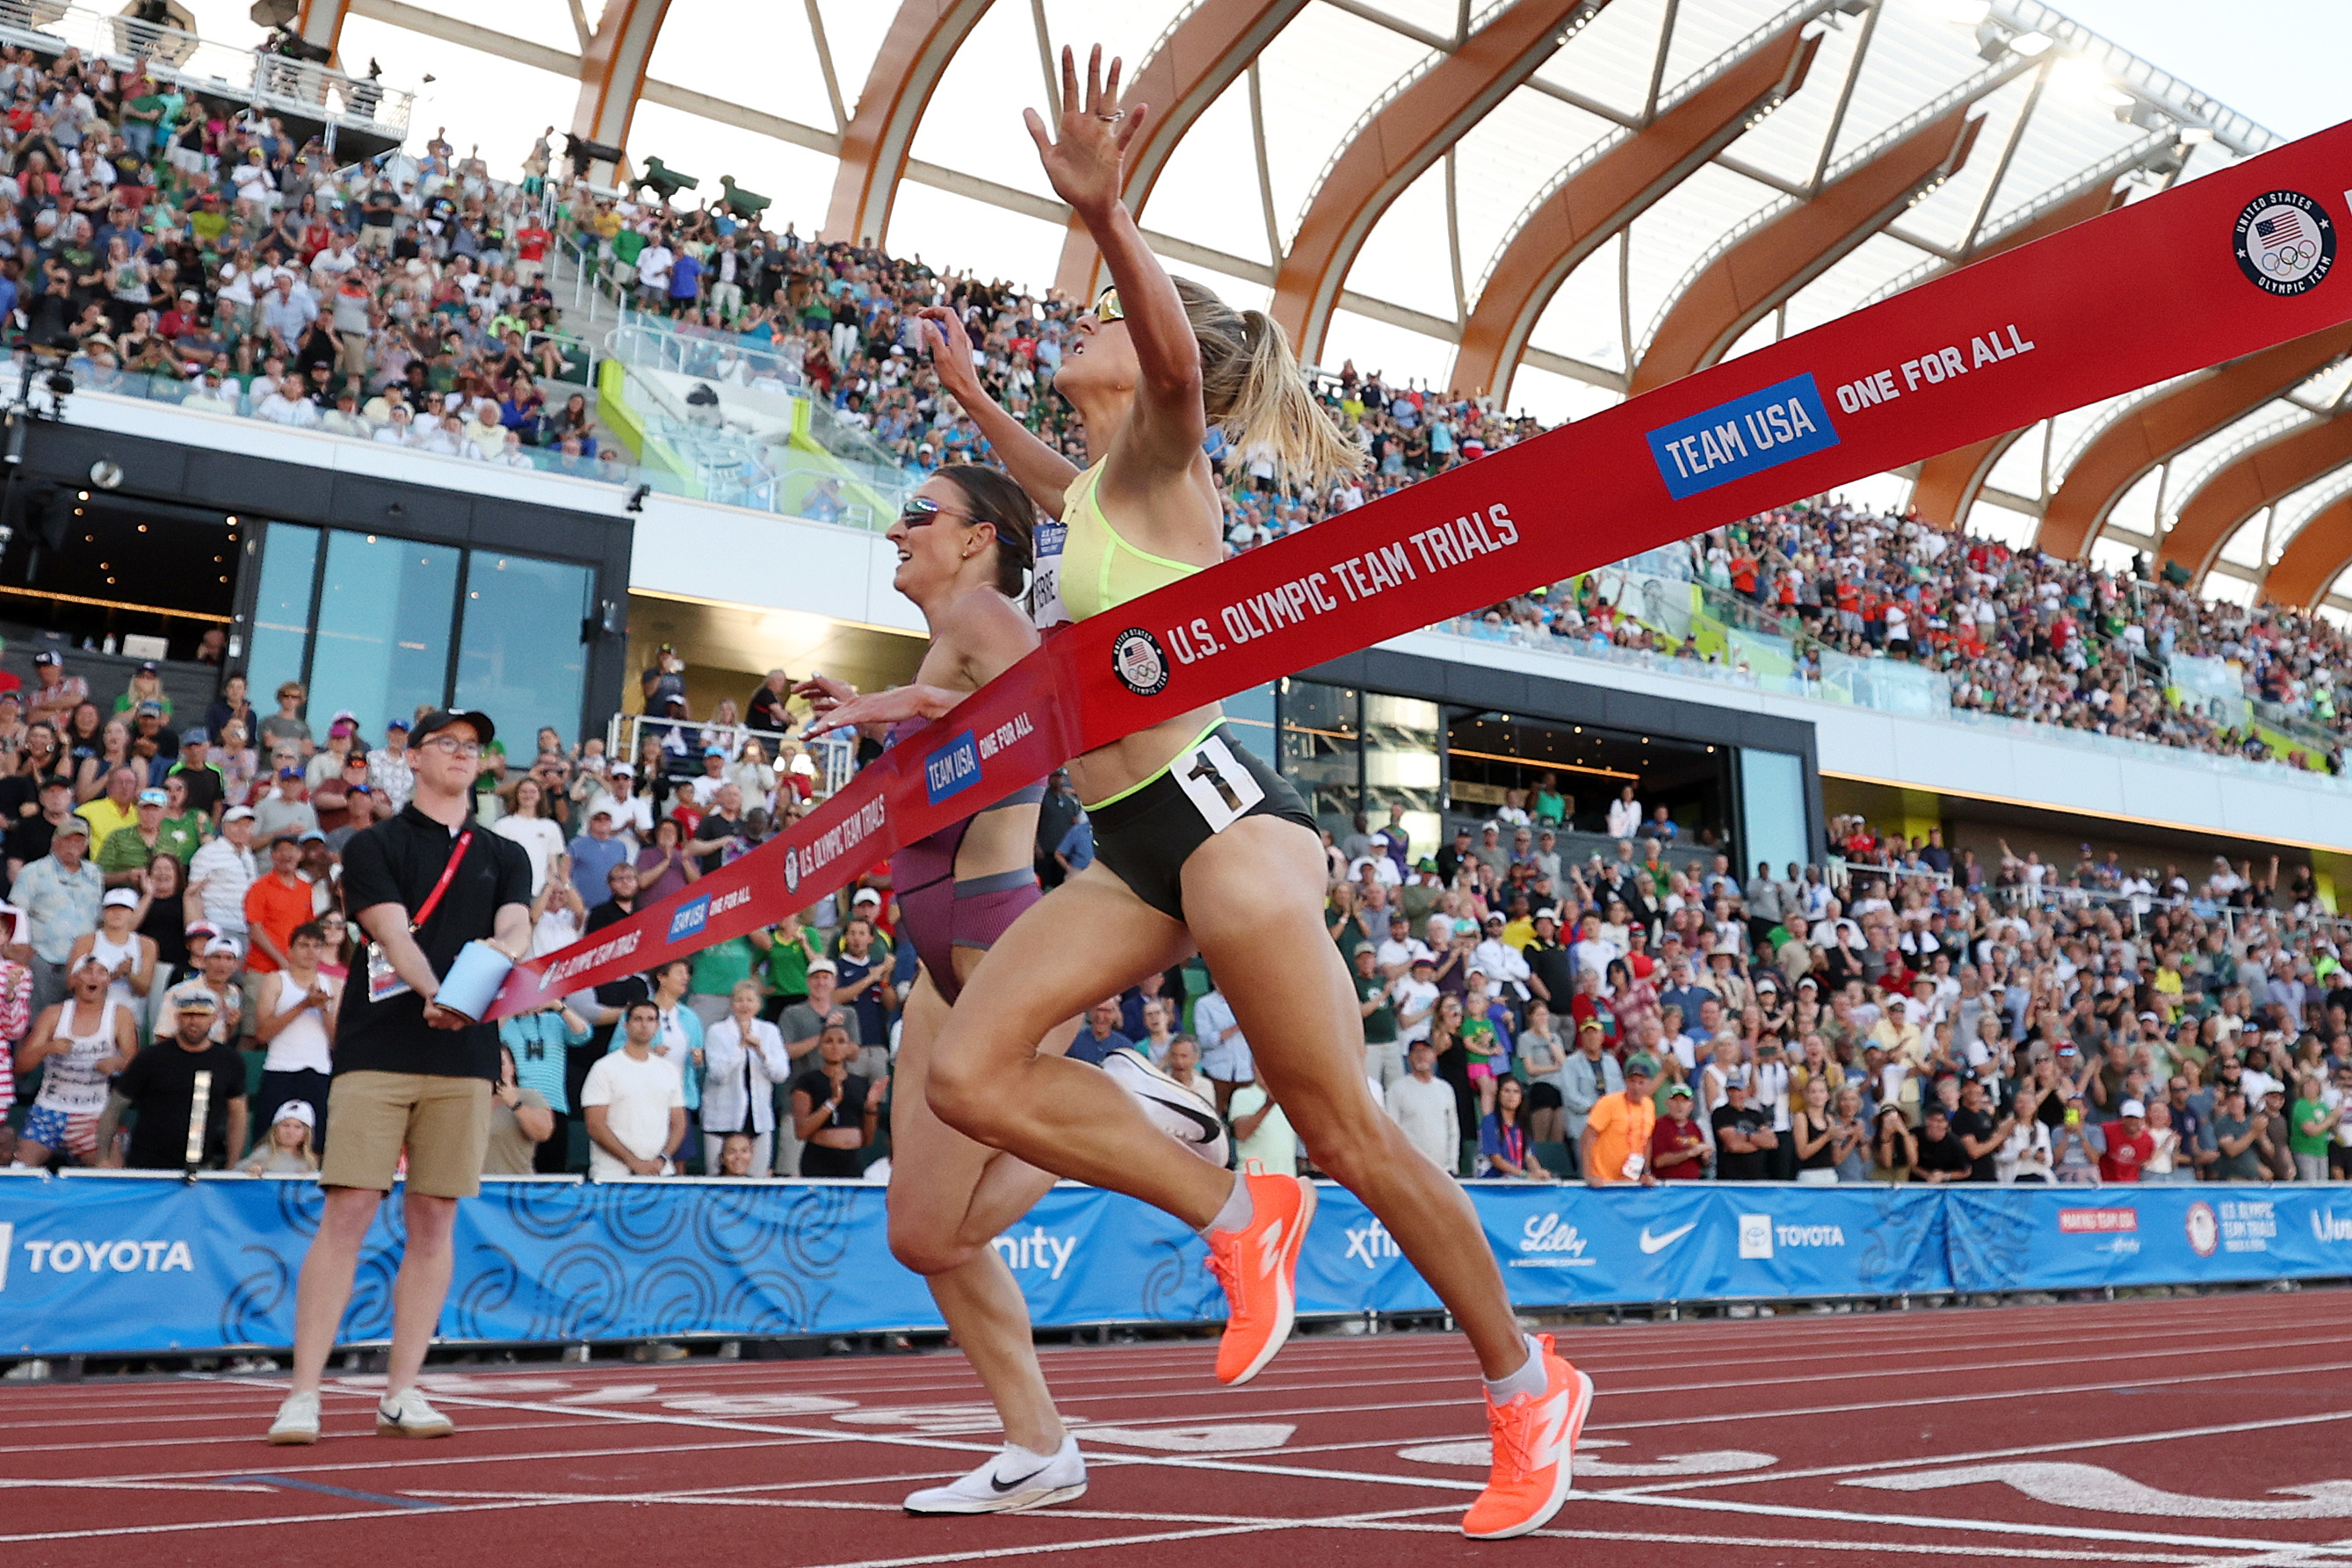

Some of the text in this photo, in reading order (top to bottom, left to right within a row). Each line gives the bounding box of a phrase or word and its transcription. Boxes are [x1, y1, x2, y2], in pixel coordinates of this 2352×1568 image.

[2236, 198, 2266, 234] UNITED
[2269, 192, 2312, 210] STATES
[2258, 256, 2332, 294] OLYMPIC TEAM
[1836, 323, 2036, 414] ONE FOR ALL
[1665, 397, 1817, 479] TEAM USA
[1167, 502, 1519, 665] U.S. OLYMPIC TEAM TRIALS
[979, 712, 1034, 760] ONE FOR ALL
[929, 744, 976, 791] TEAM USA
[1187, 750, 1243, 813] 1
[799, 793, 886, 878] U.S. OLYMPIC TEAM TRIALS
[24, 1239, 195, 1274] TOYOTA
[1519, 1211, 1589, 1259] Lilly
[1776, 1225, 1846, 1247] TOYOTA
